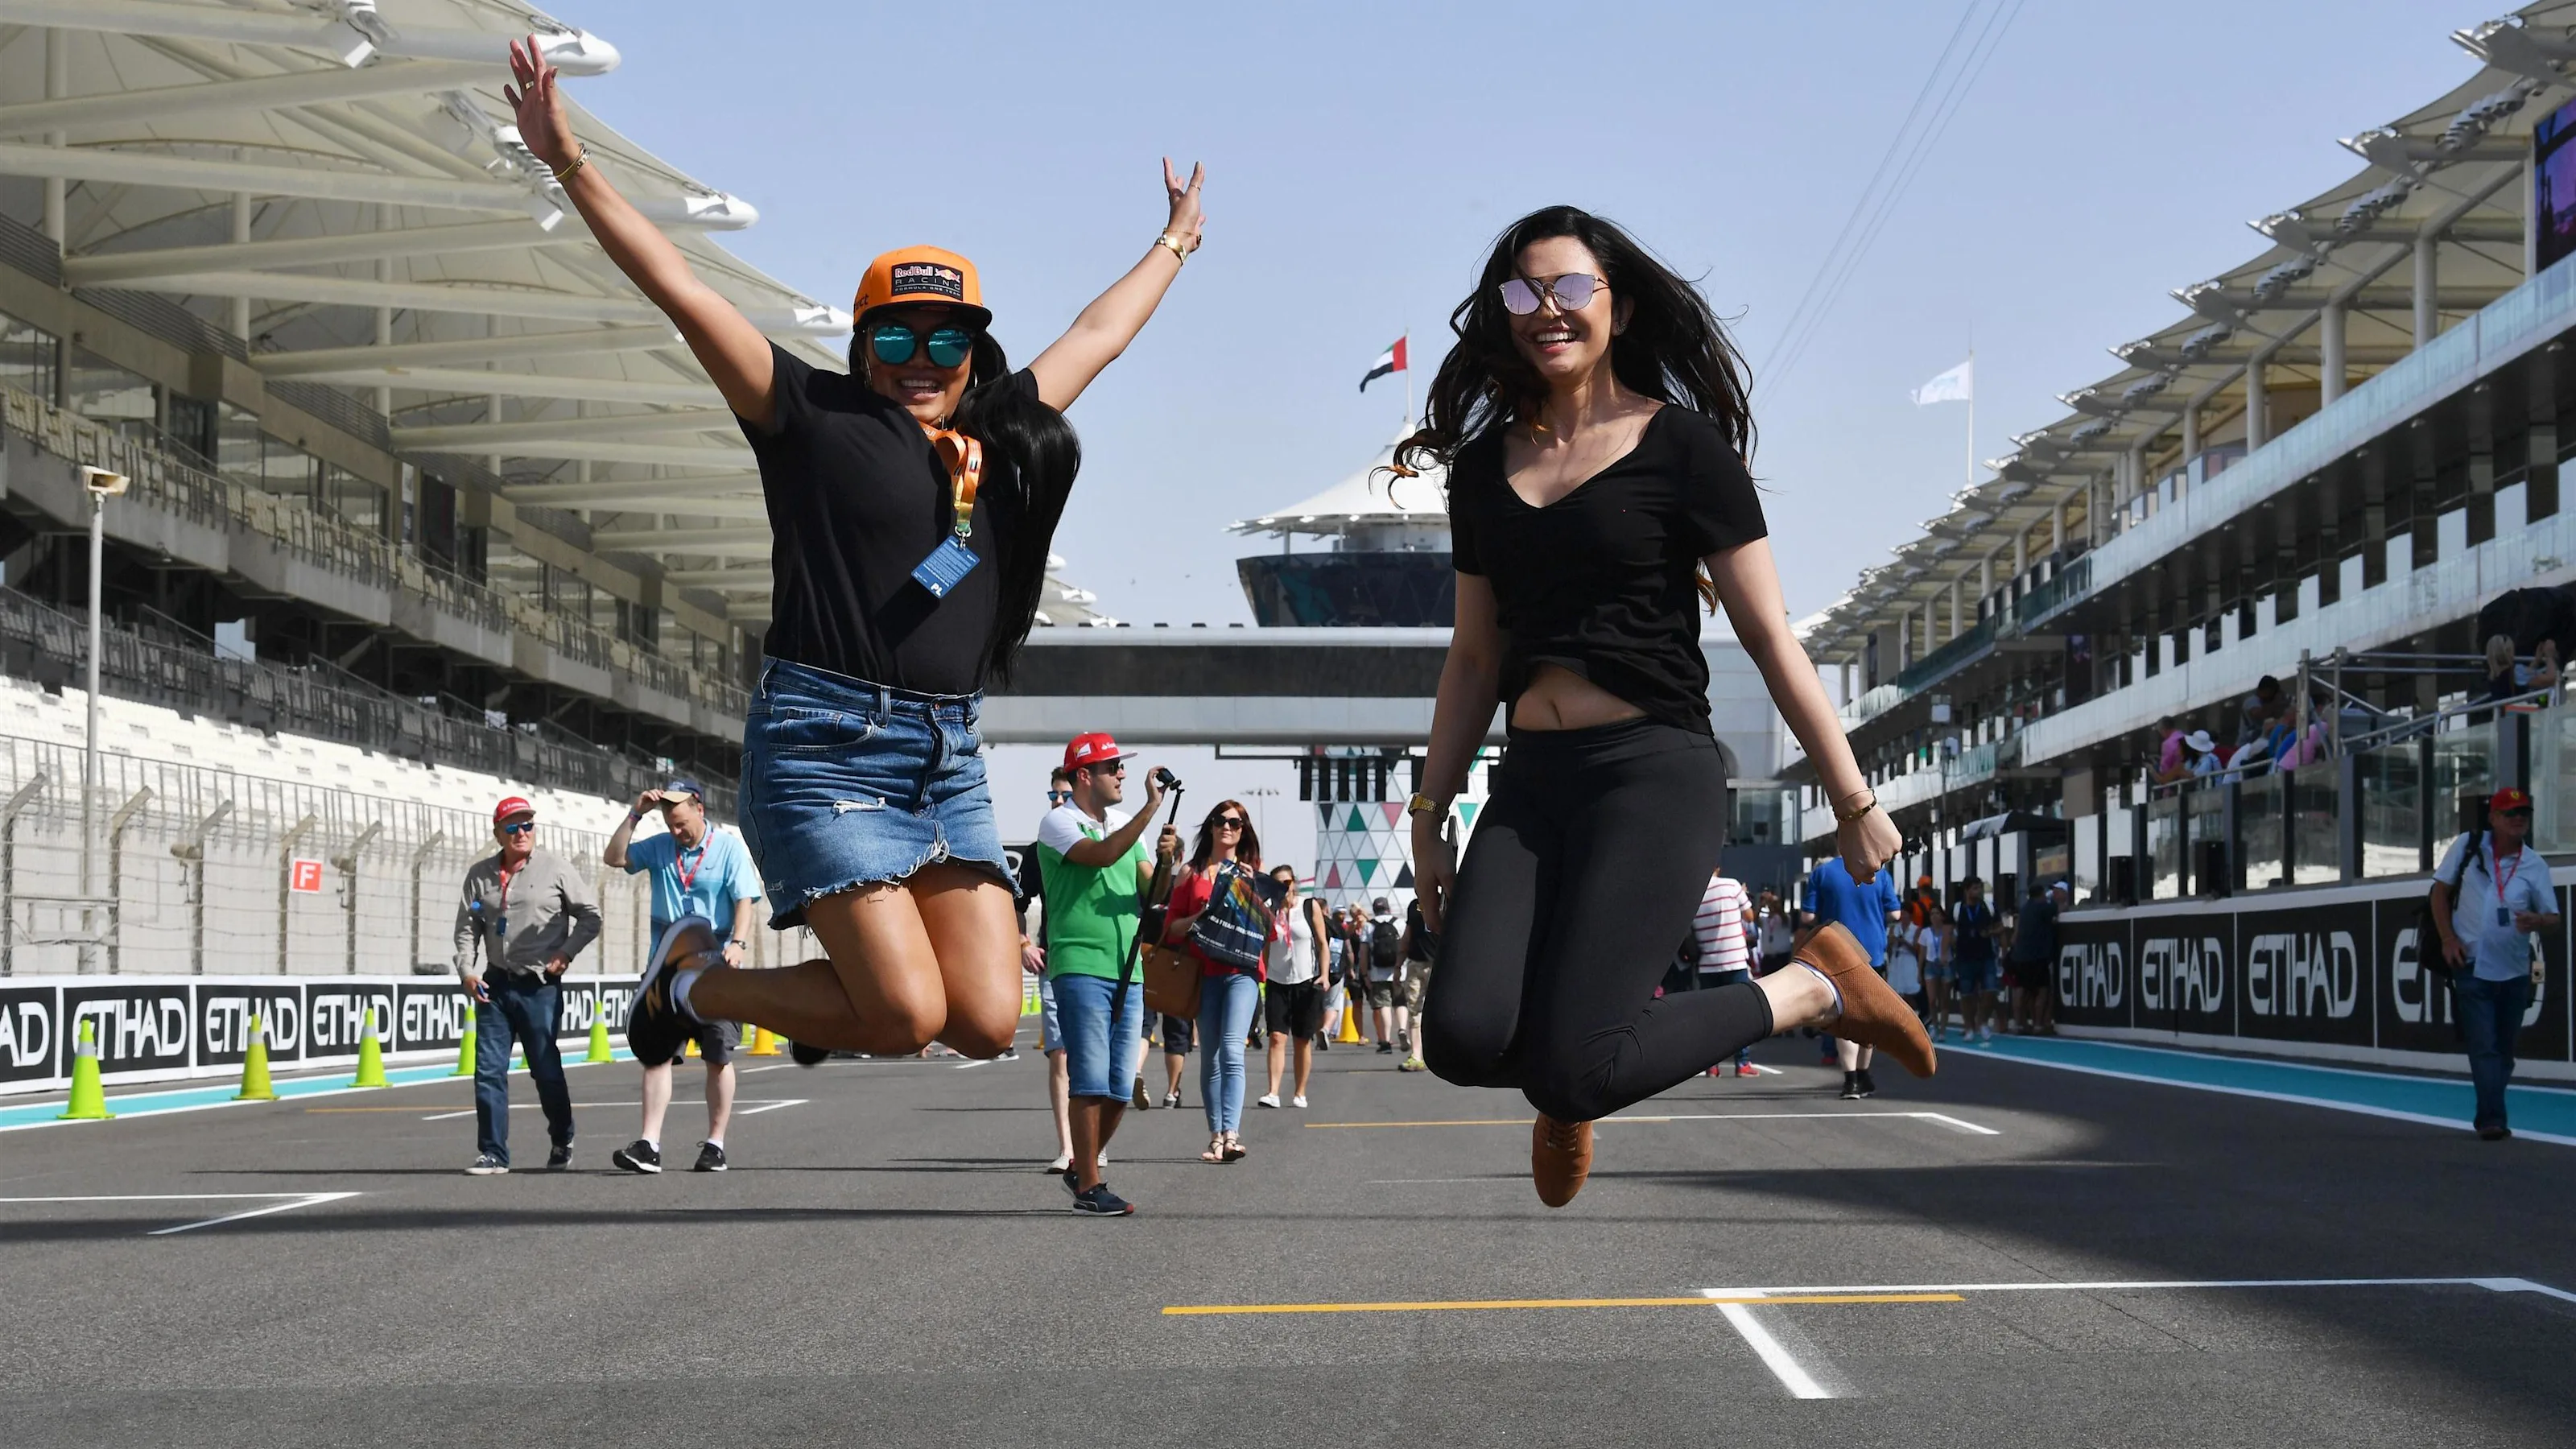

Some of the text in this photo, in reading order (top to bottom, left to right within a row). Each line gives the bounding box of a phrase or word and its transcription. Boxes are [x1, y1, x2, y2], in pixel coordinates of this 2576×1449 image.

[895, 266, 933, 278] Red Bull
[895, 278, 961, 291] RACING
[945, 288, 960, 296] TEAM
[930, 582, 944, 597] PL
[299, 865, 316, 887] F
[2059, 941, 2123, 1008] ETIHAD
[2141, 937, 2223, 1012] ETIHAD
[2248, 931, 2358, 1018] ETIHAD
[205, 997, 298, 1053] ETIHAD
